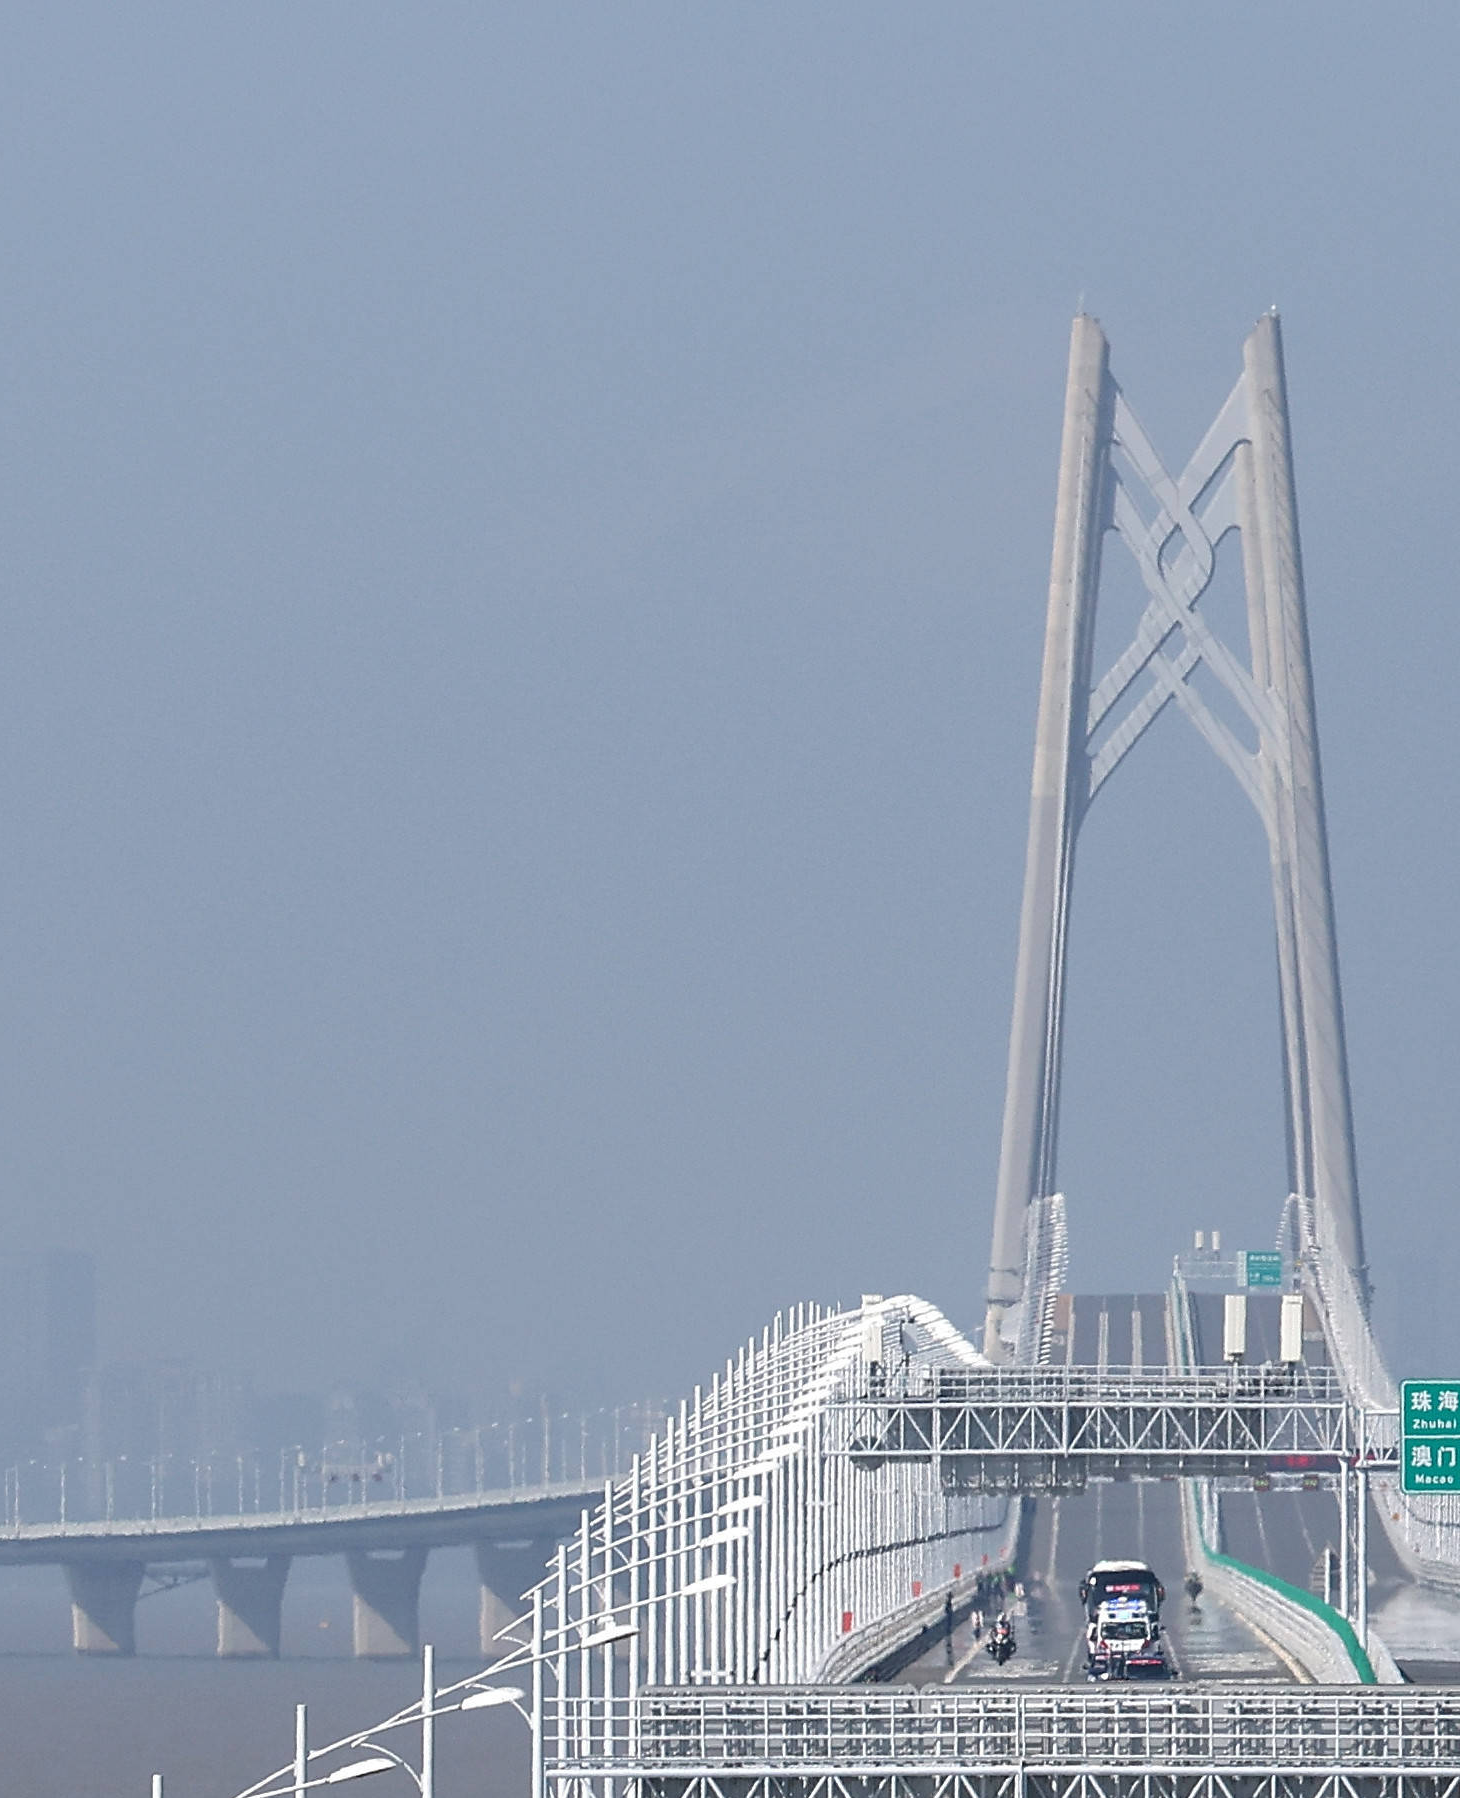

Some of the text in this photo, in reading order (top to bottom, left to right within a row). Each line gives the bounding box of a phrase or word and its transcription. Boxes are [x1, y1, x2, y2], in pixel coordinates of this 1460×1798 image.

[1411, 1390, 1459, 1411] 珠海
[1413, 1419, 1457, 1429] Zhuhai
[1411, 1445, 1457, 1467] 澳门
[1415, 1474, 1454, 1484] Macao
